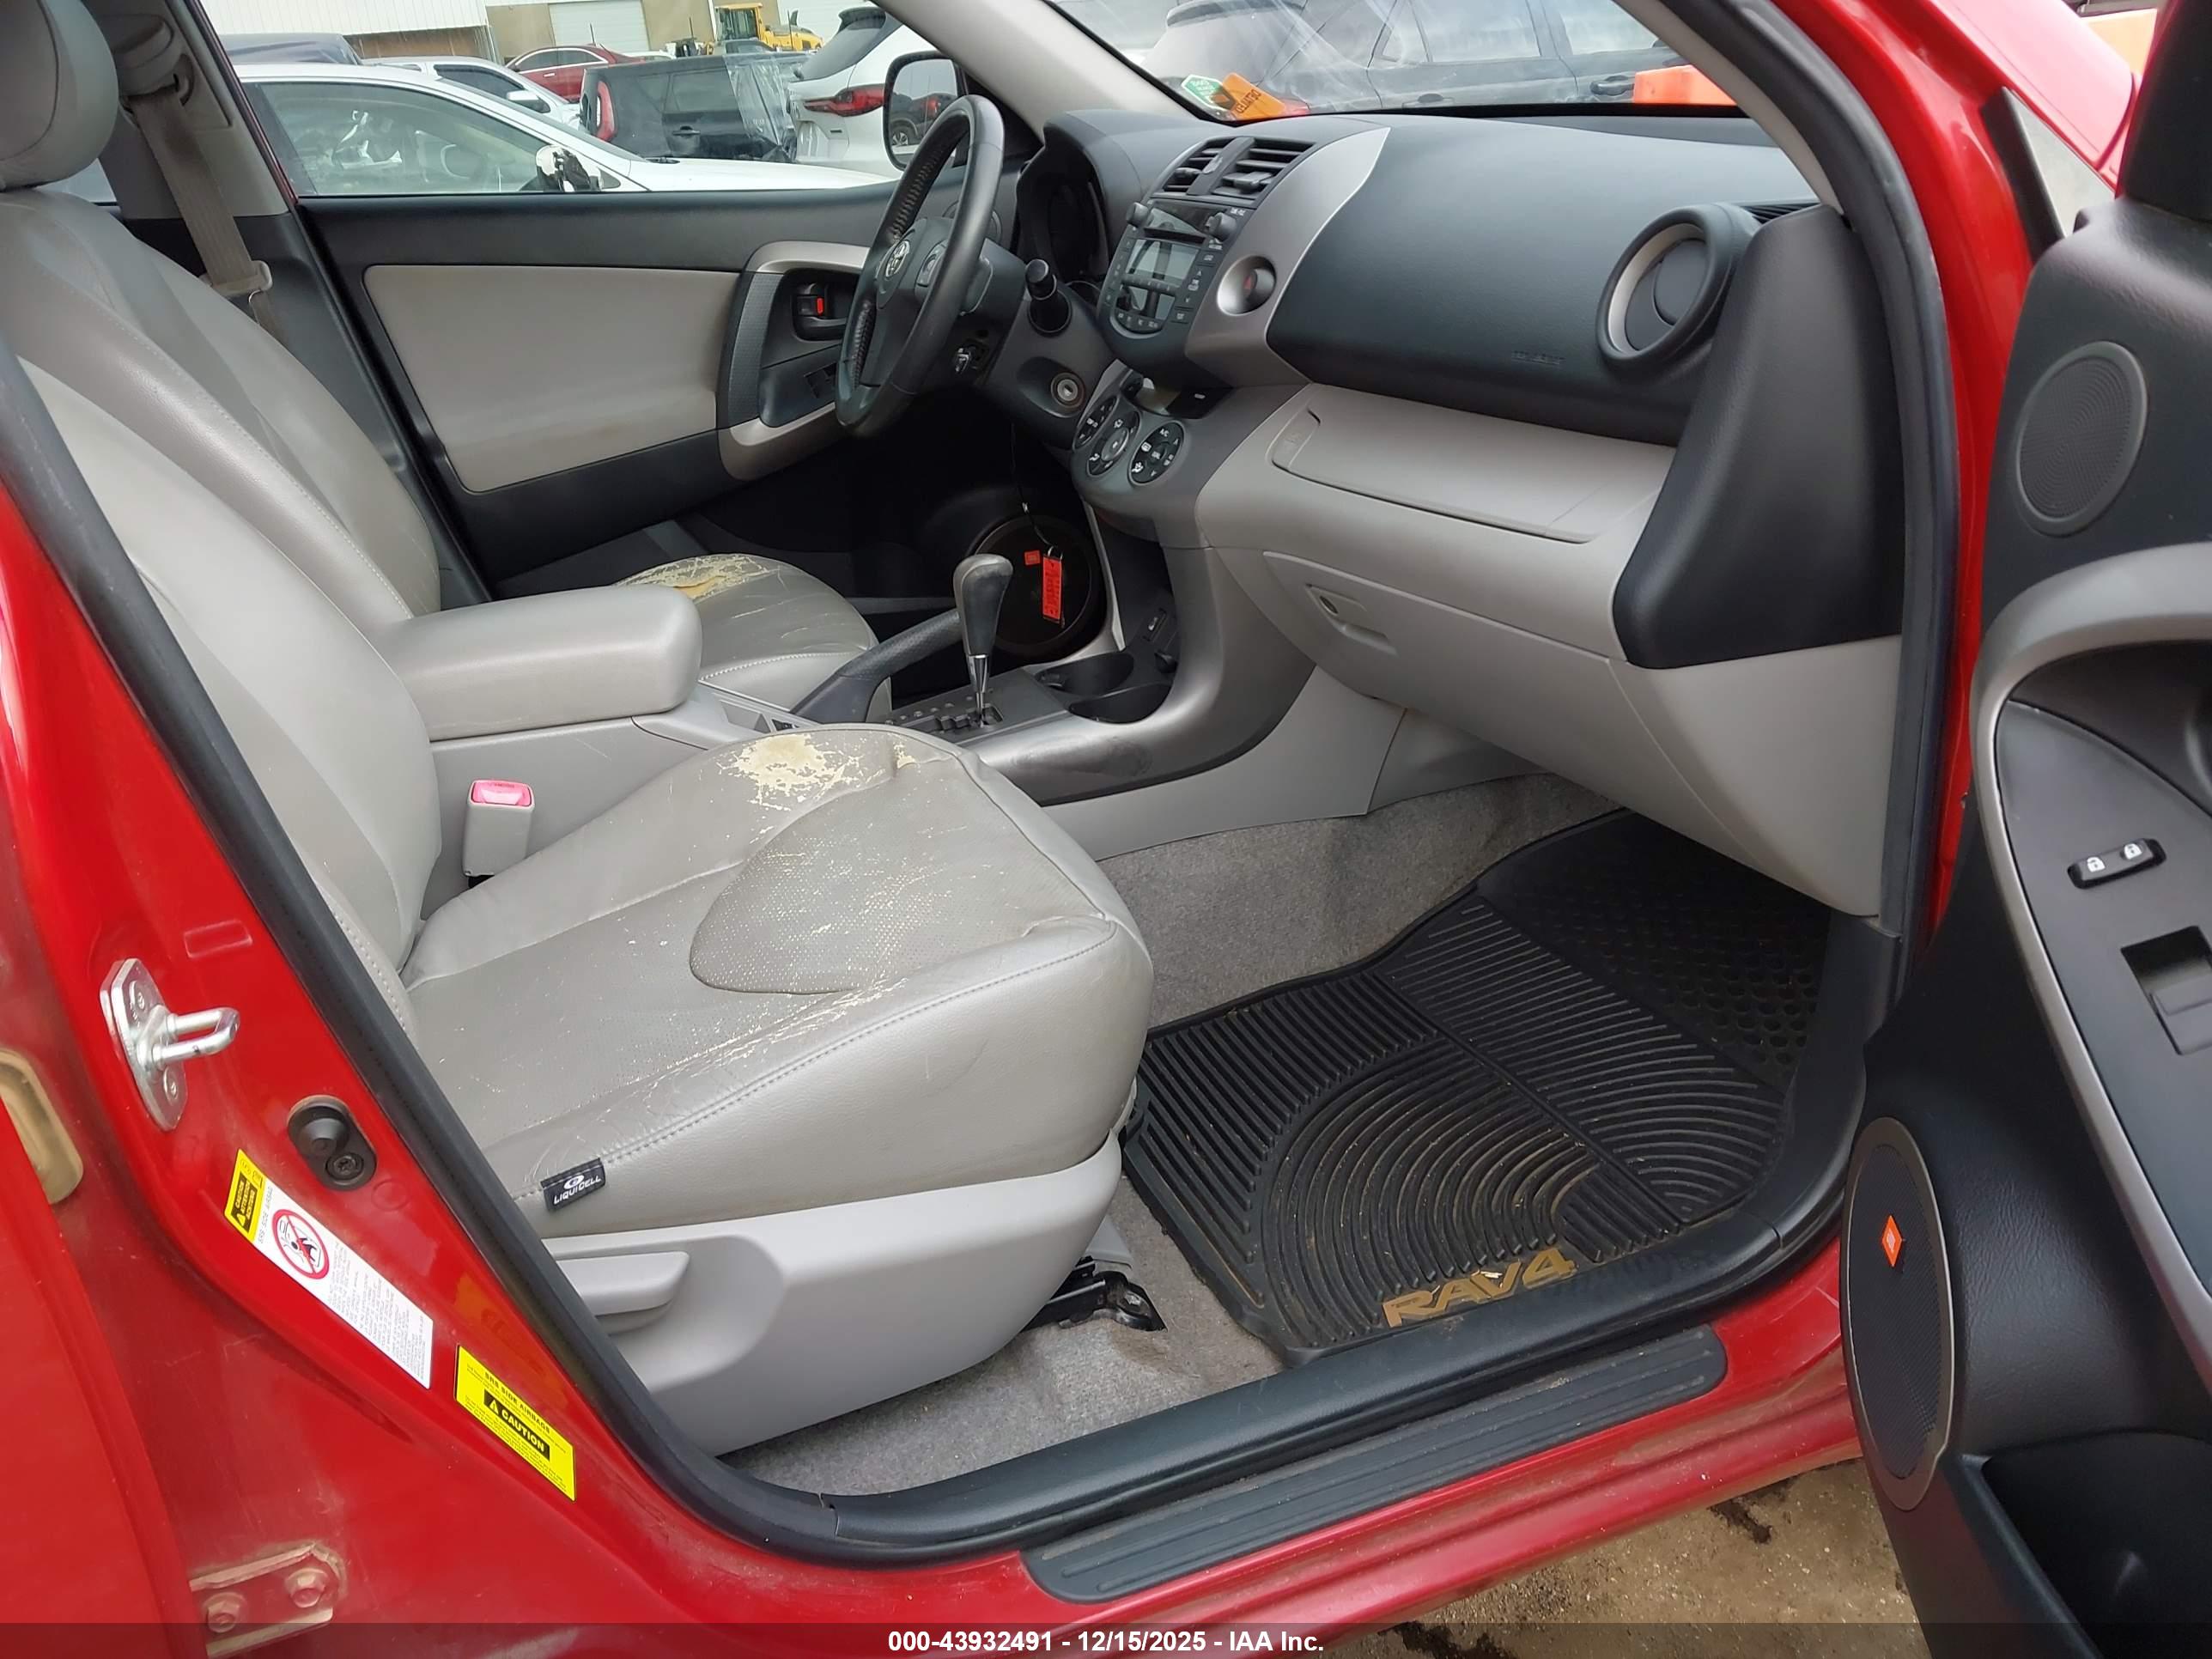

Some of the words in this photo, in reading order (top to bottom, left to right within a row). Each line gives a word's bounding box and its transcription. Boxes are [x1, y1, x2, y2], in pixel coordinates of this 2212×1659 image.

[554, 1175, 602, 1205] LIQUICELL
[1382, 1247, 1578, 1328] RAV4
[484, 1371, 500, 1389] SRS
[501, 1384, 519, 1404] SIDE
[520, 1402, 551, 1435] AIRBAGS
[501, 1408, 545, 1453] CAUTION
